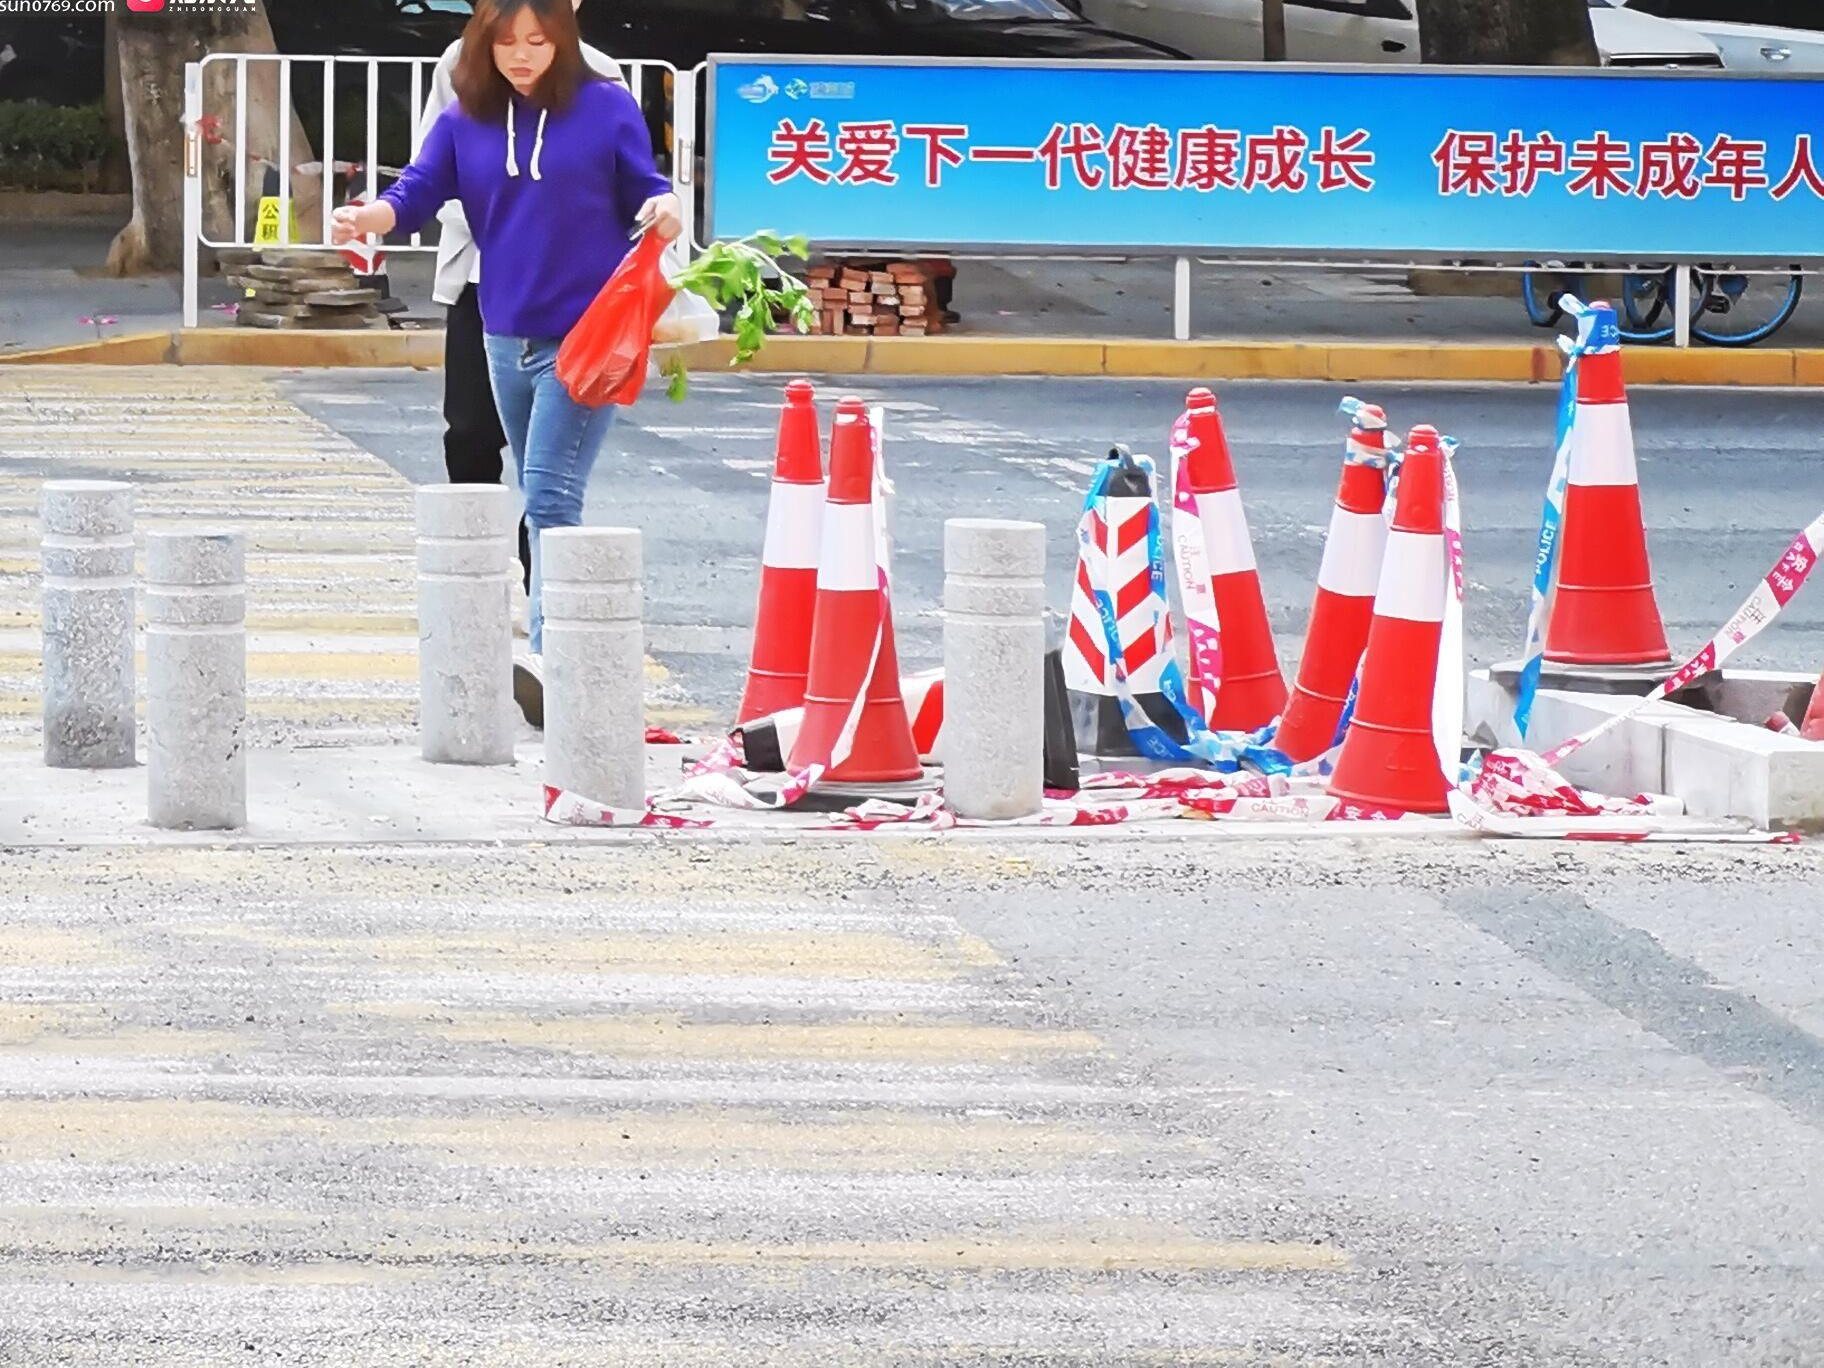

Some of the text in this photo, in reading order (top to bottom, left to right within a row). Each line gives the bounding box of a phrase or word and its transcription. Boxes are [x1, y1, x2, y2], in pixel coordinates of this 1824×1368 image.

[768, 118, 1373, 192] 关爱下一代健康成长
[1431, 130, 1824, 200] 保护未成年人
